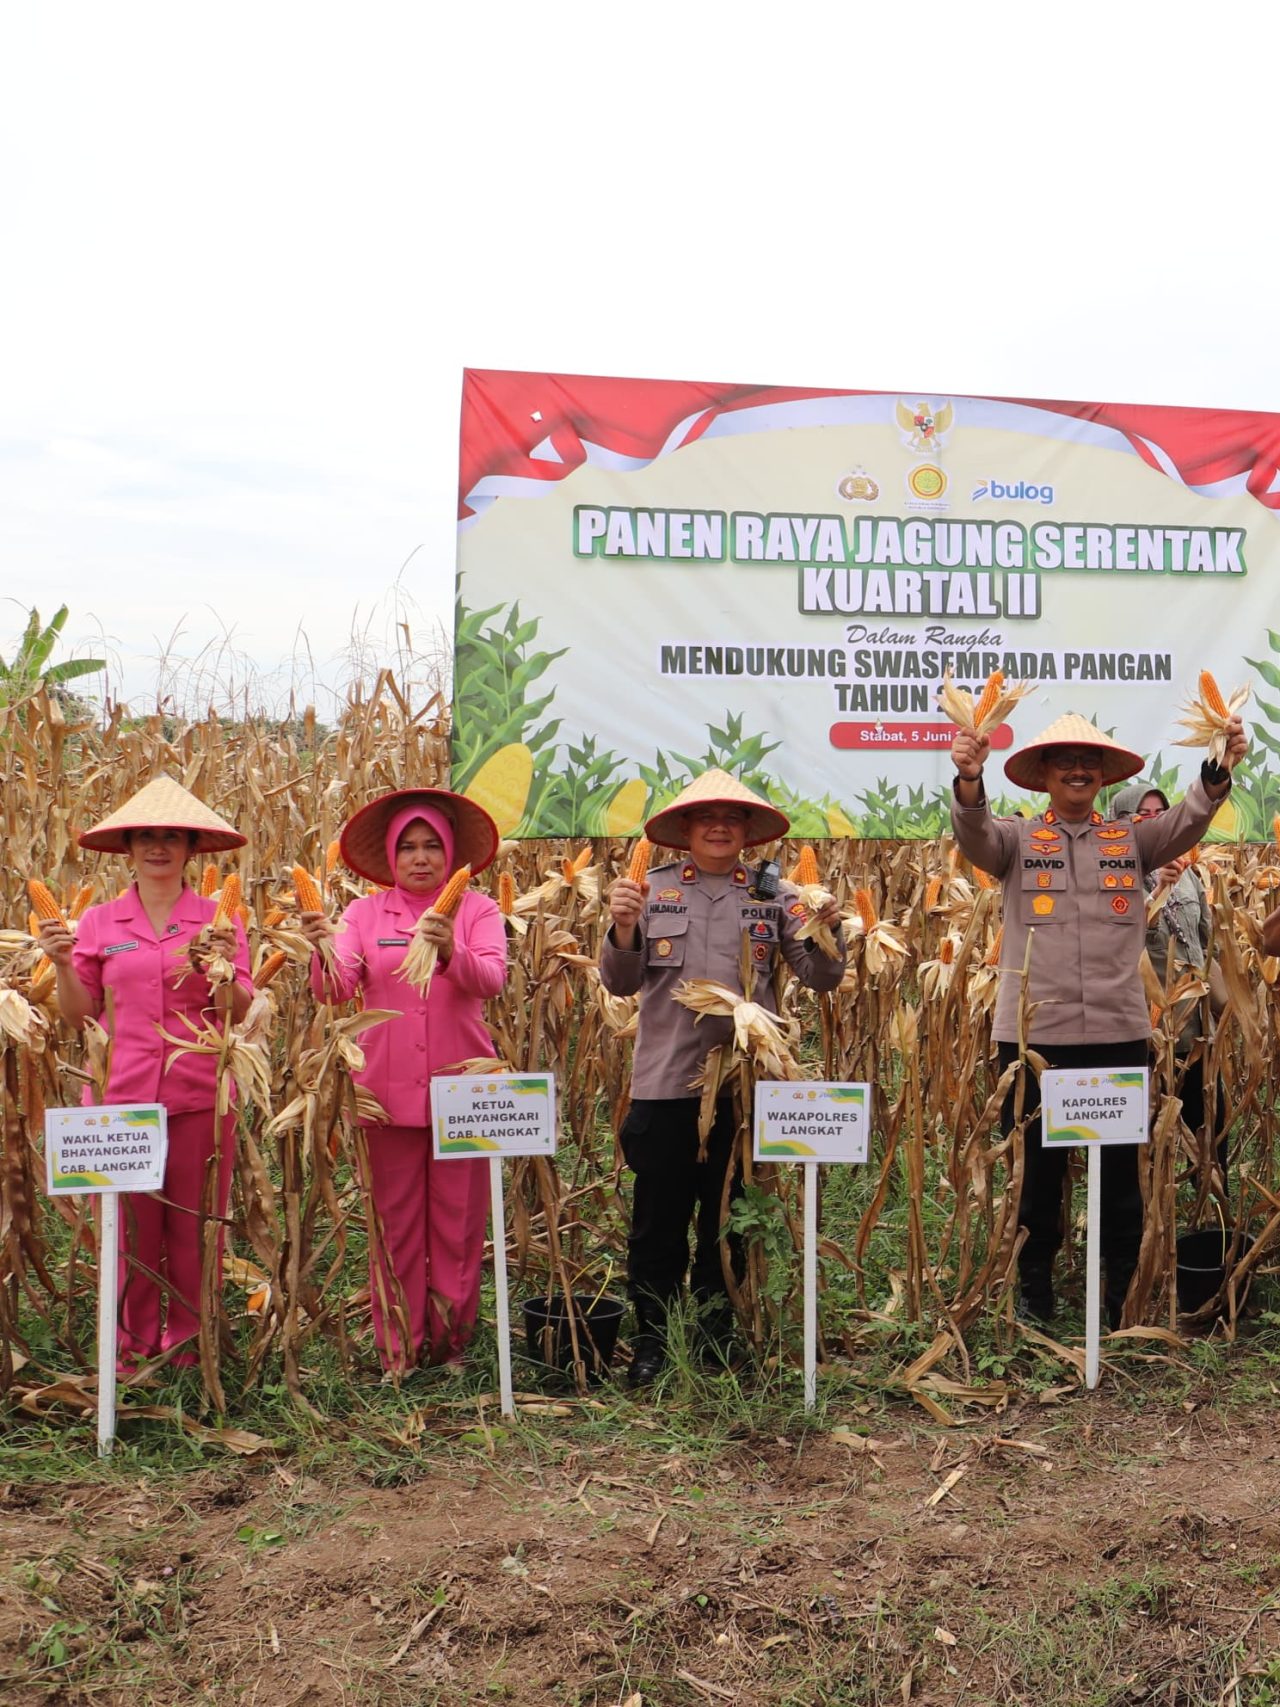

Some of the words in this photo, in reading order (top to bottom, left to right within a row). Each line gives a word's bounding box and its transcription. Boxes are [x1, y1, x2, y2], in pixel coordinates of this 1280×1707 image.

[990, 480, 1053, 504] bulog
[576, 507, 723, 560] PANEN
[734, 514, 846, 564] RAYA
[853, 518, 1026, 569] JAGUNG
[1033, 525, 1244, 574] SERENTAK
[802, 567, 1000, 616] KUARTAL
[1005, 572, 1038, 616] II
[846, 624, 918, 645] Dalam
[924, 625, 1004, 652] Rangka
[660, 645, 847, 678] MENDUKUNG
[853, 649, 1058, 680] SWASEMBADA
[1063, 653, 1172, 681] PANGAN
[833, 683, 929, 713] TAHUN
[860, 730, 907, 743] Stabat,
[911, 731, 919, 742] 5
[923, 730, 952, 742] Juni
[1024, 858, 1065, 869] DAVID
[1099, 859, 1136, 869] POLRI
[741, 908, 777, 919] POLRI
[472, 1100, 515, 1110] KETUA
[1062, 1096, 1127, 1108] KAPOLRES
[448, 1112, 539, 1125] BHAYANGKARI
[767, 1111, 858, 1122] WAKAPOLRES
[1066, 1110, 1124, 1121] LANGKAT
[447, 1130, 478, 1140] CAB.
[481, 1127, 541, 1138] LANGKAT
[781, 1125, 843, 1136] LANGKAT
[62, 1134, 104, 1145] WAKIL
[107, 1131, 149, 1143] KETUA
[61, 1145, 151, 1159] BHAYANGKARI
[60, 1163, 90, 1175] CAB.
[94, 1160, 152, 1173] LANGKAT
